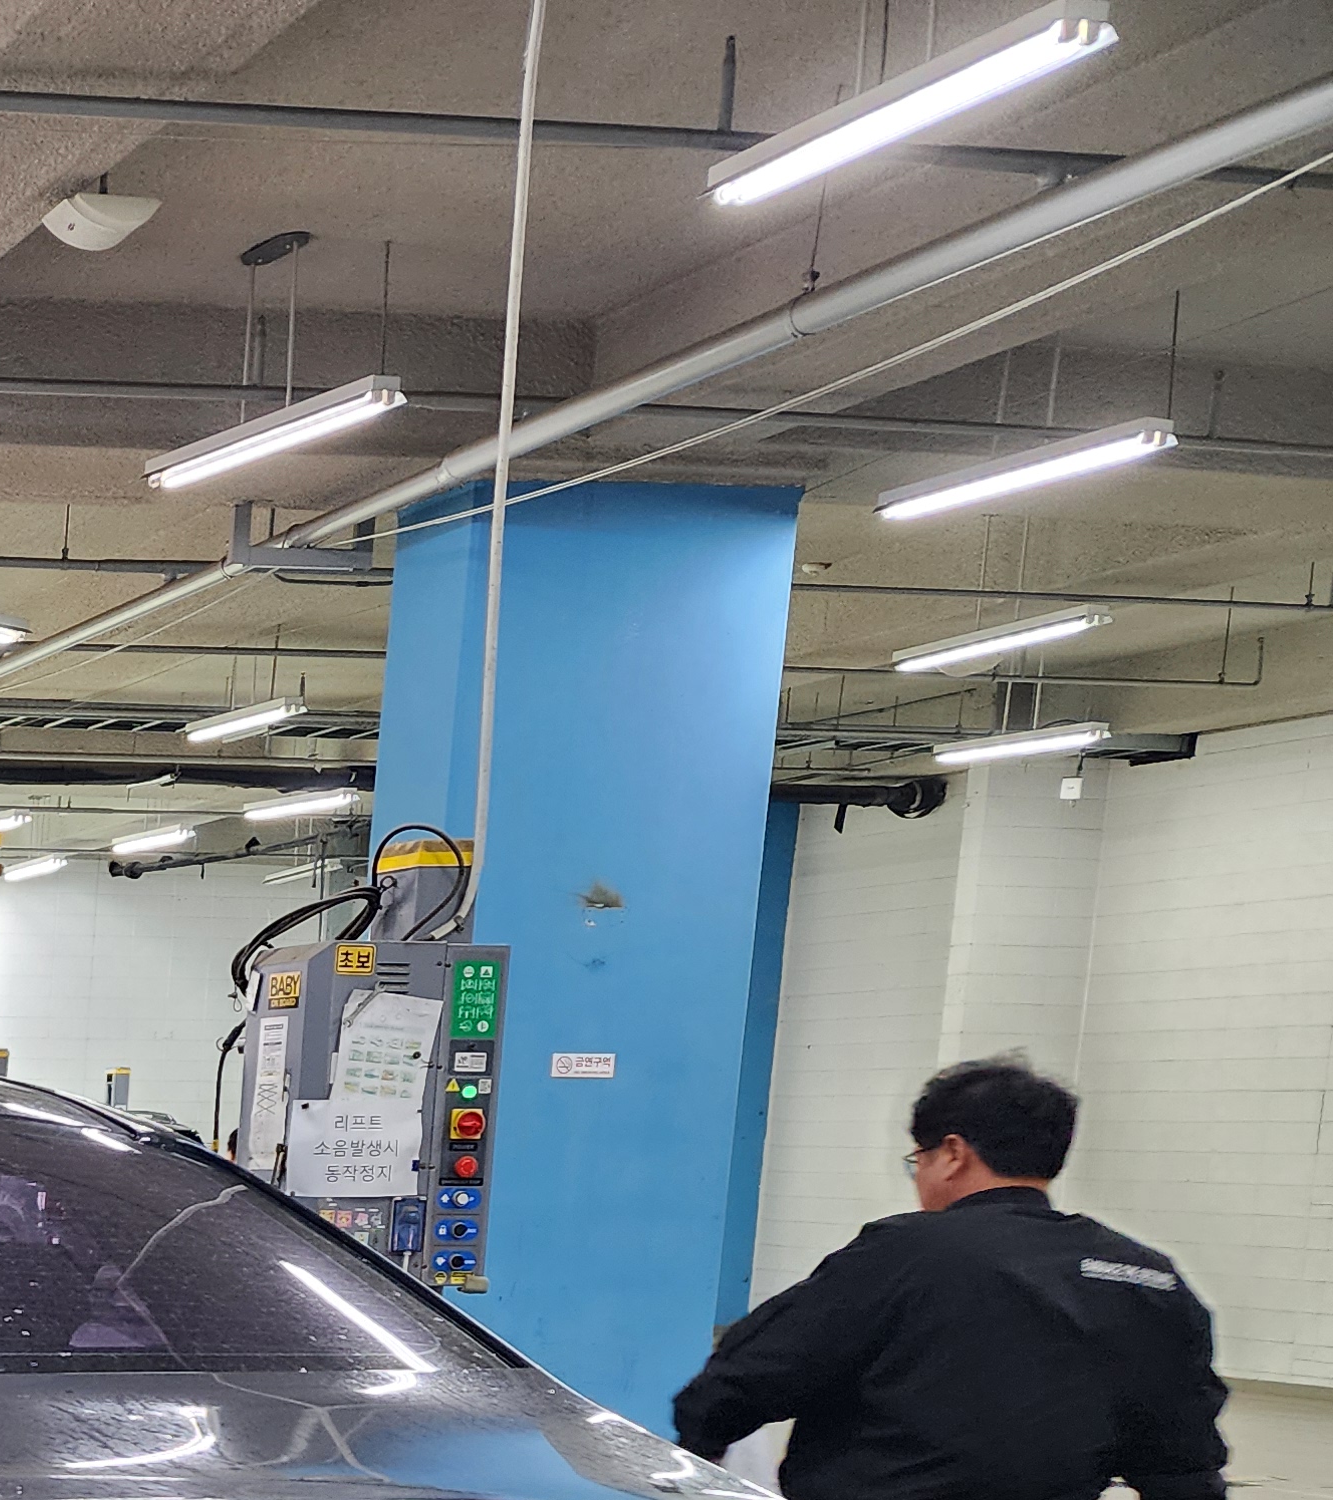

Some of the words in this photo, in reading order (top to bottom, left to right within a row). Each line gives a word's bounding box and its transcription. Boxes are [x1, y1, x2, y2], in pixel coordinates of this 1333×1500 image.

[338, 949, 371, 969] 초보
[270, 974, 301, 997] BABY
[575, 1056, 612, 1068] 금연구역
[334, 1114, 383, 1132] 리프트
[313, 1139, 399, 1158] 소음발생시
[324, 1164, 393, 1183] 동작정지
